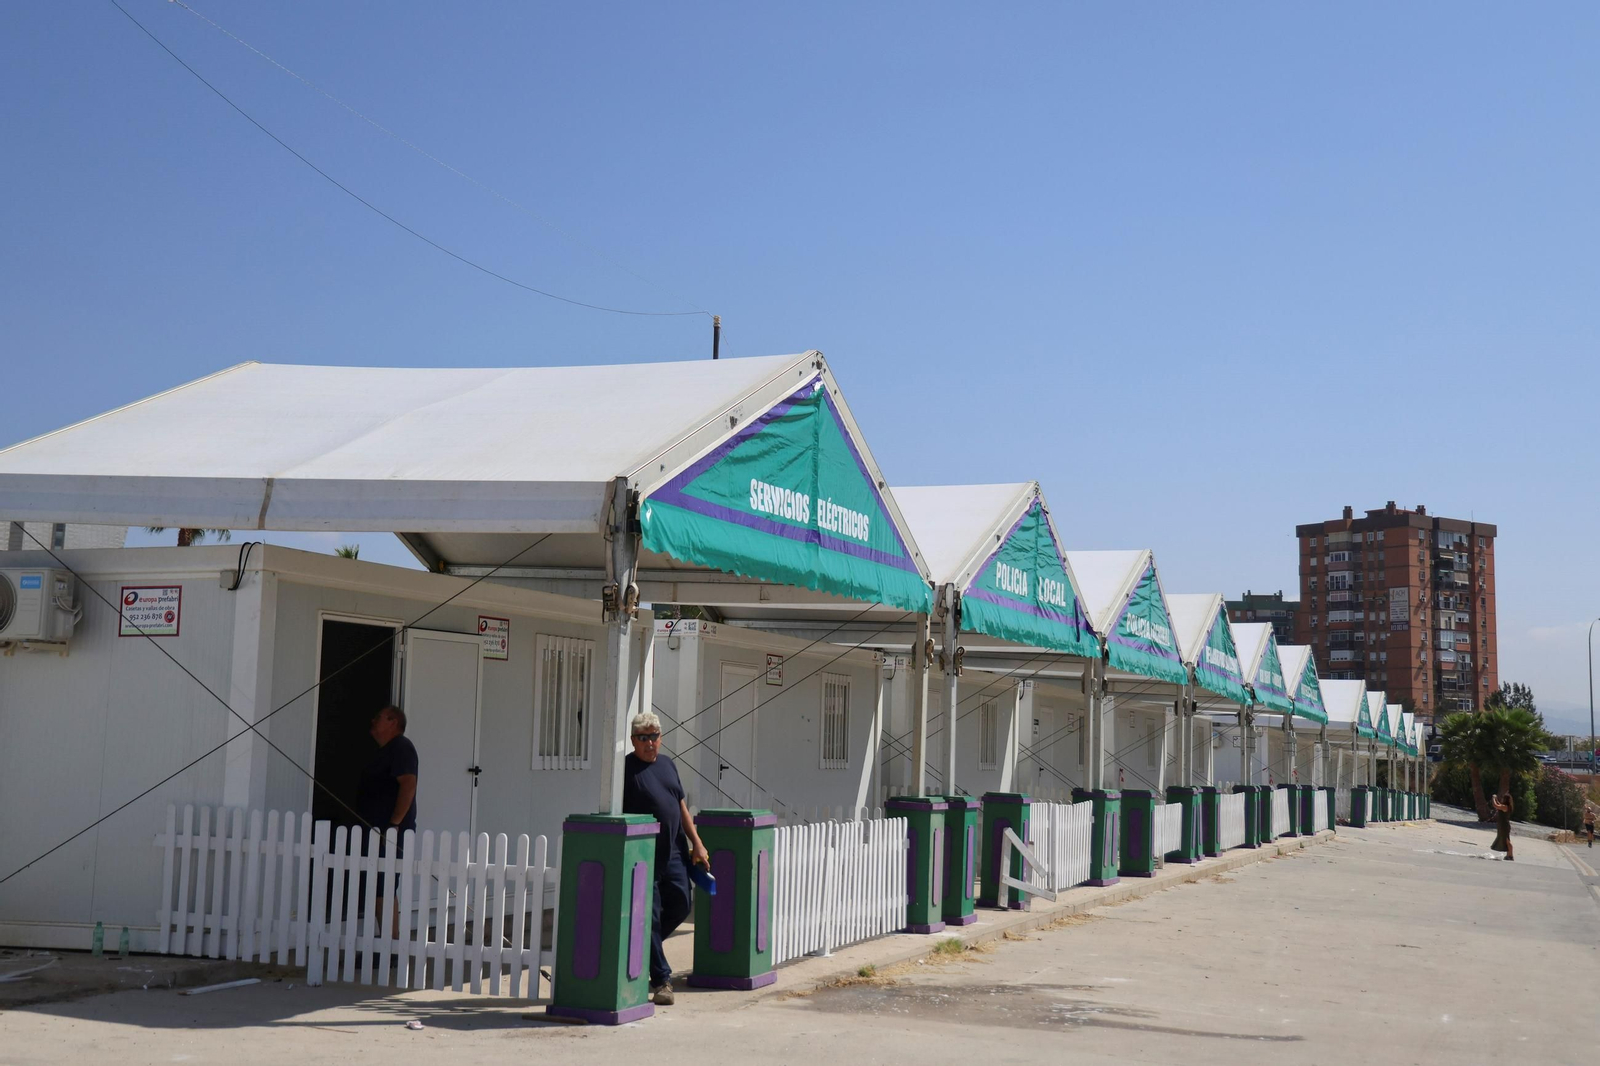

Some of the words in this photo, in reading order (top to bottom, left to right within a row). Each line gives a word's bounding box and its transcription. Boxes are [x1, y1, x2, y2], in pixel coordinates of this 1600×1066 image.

[749, 478, 810, 524] SERVICIOS
[817, 497, 869, 542] ELÉCTRICOS
[996, 561, 1028, 597] POLICIA
[1038, 576, 1067, 607] LOCAL
